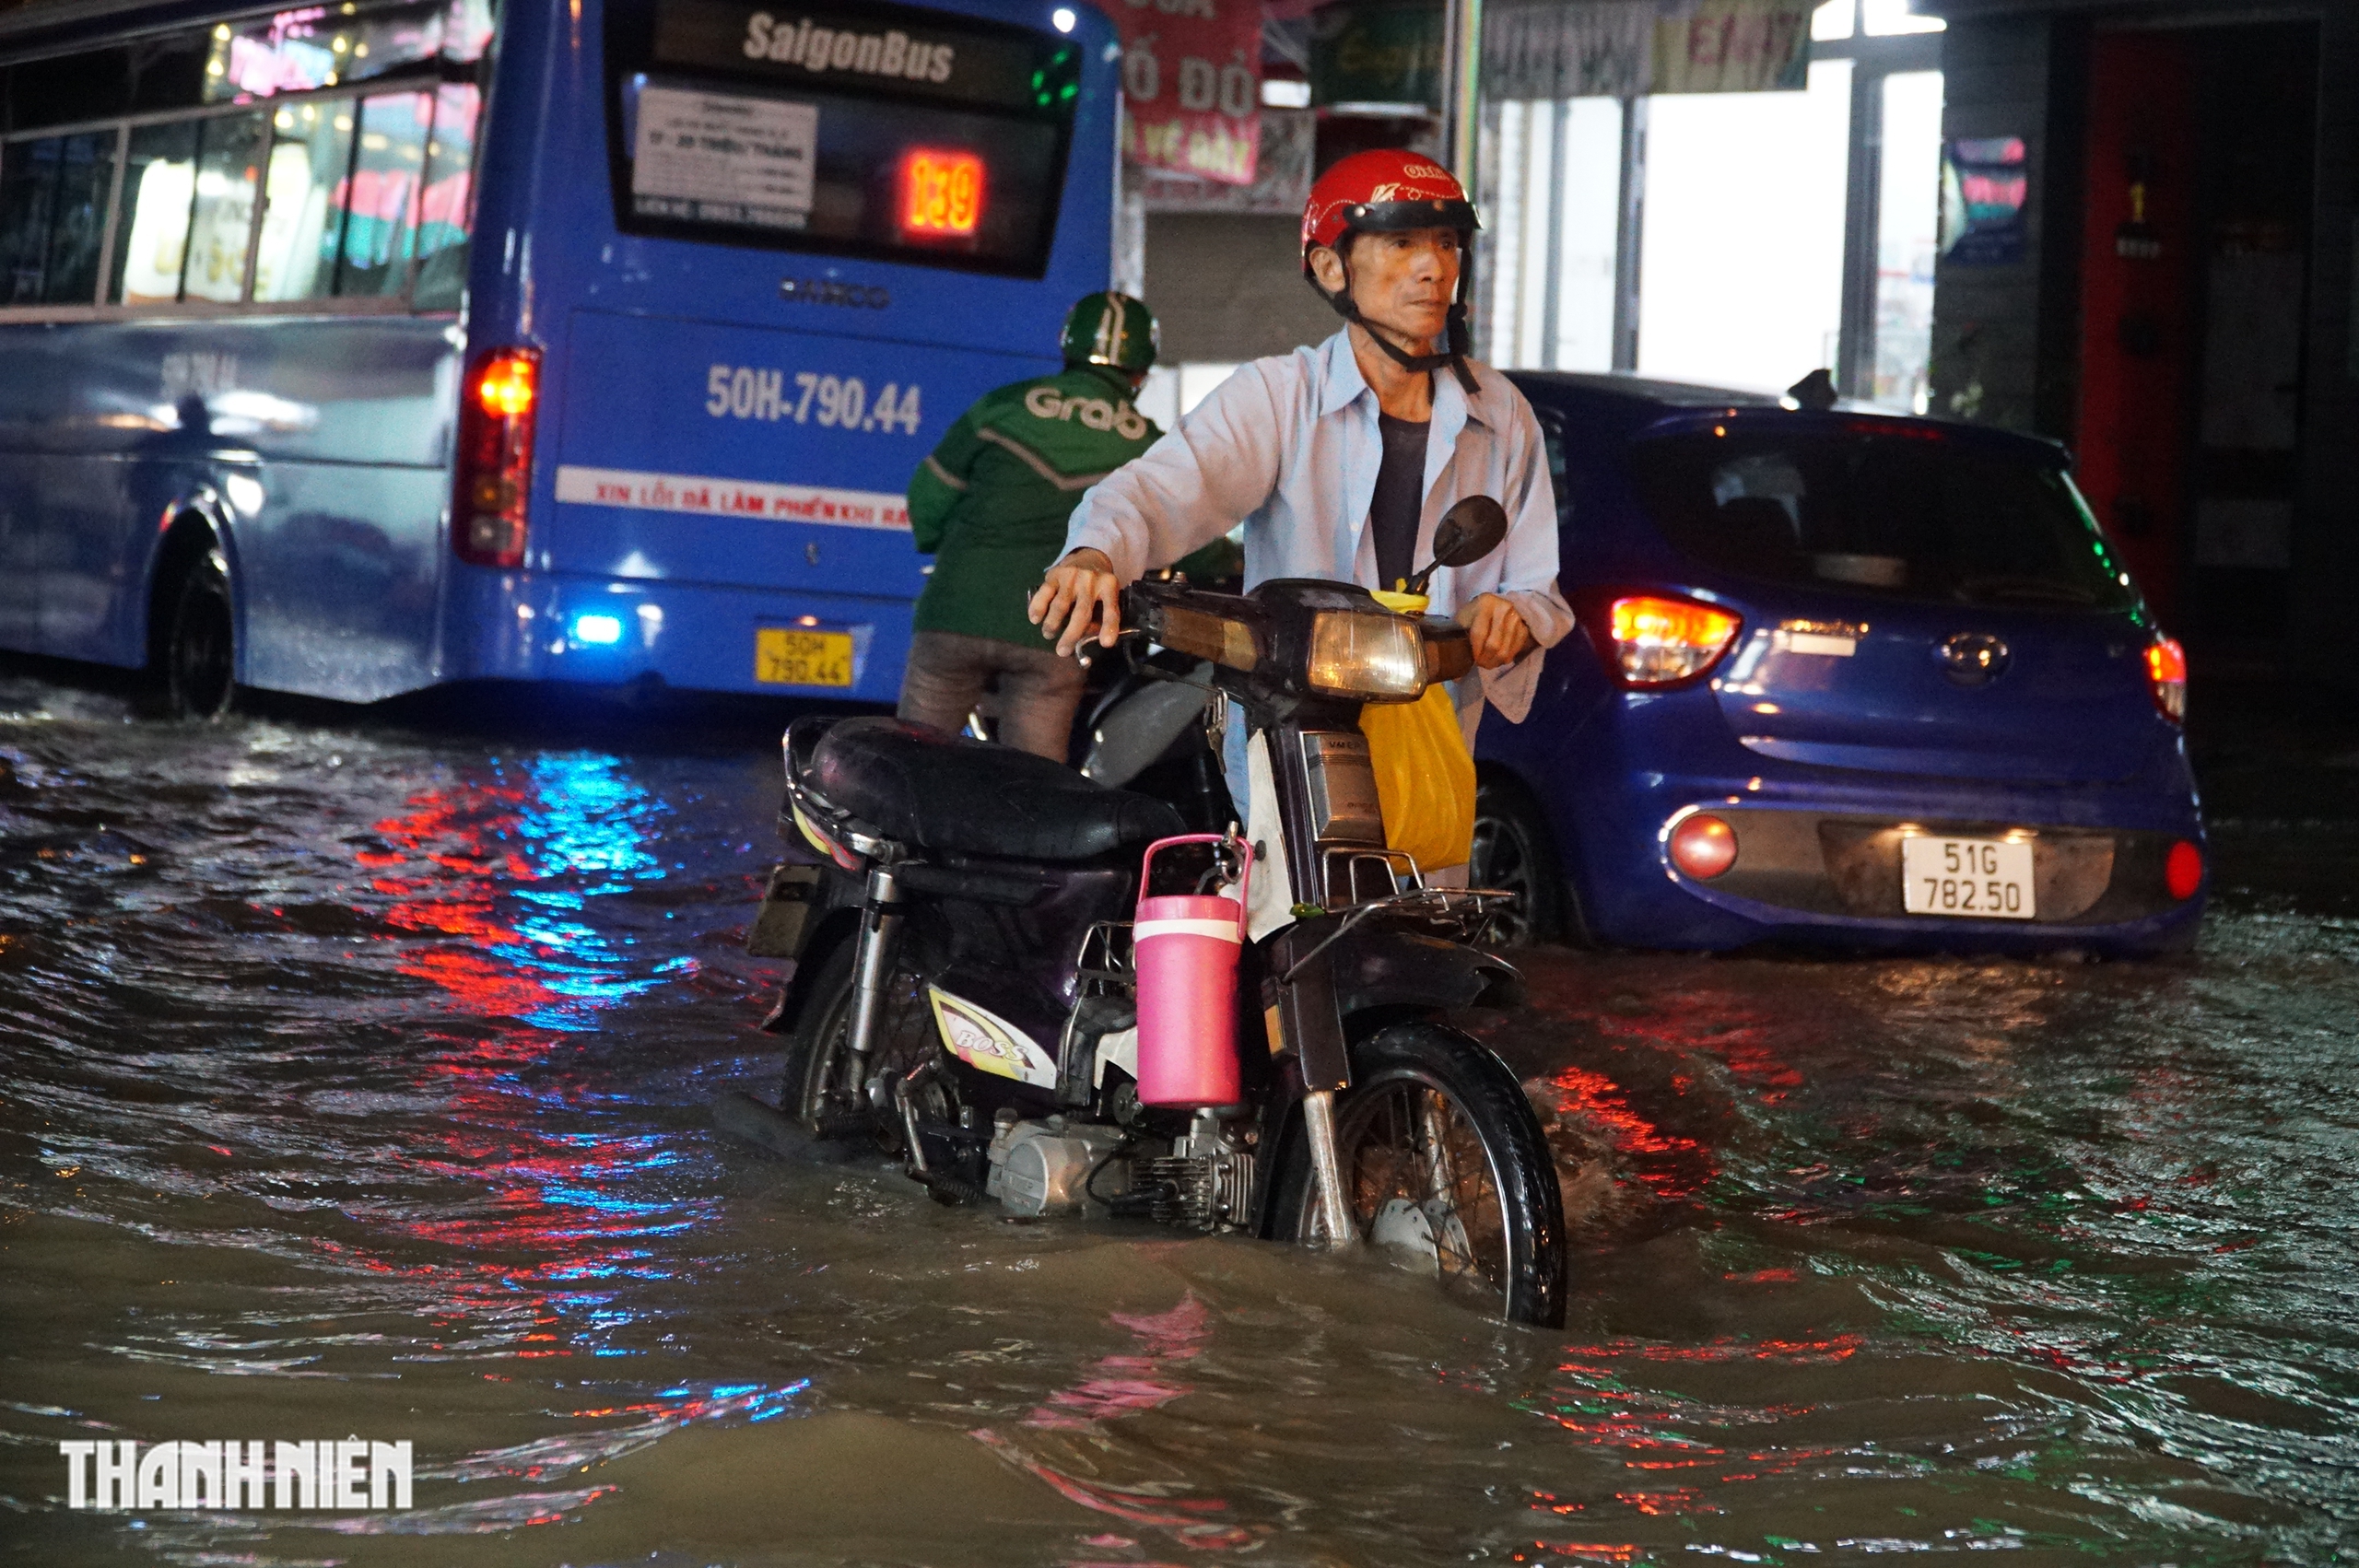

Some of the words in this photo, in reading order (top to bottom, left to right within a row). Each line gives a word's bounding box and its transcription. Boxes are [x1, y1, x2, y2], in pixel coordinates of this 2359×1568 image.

[743, 11, 955, 83] SaigonBus
[910, 153, 978, 231] 139
[706, 363, 921, 435] 50H-790.44
[1025, 387, 1148, 440] Grab
[595, 483, 631, 503] XIN
[1944, 842, 1998, 875] 51G
[1923, 878, 2021, 913] 782.50
[957, 1030, 1028, 1061] BOSS
